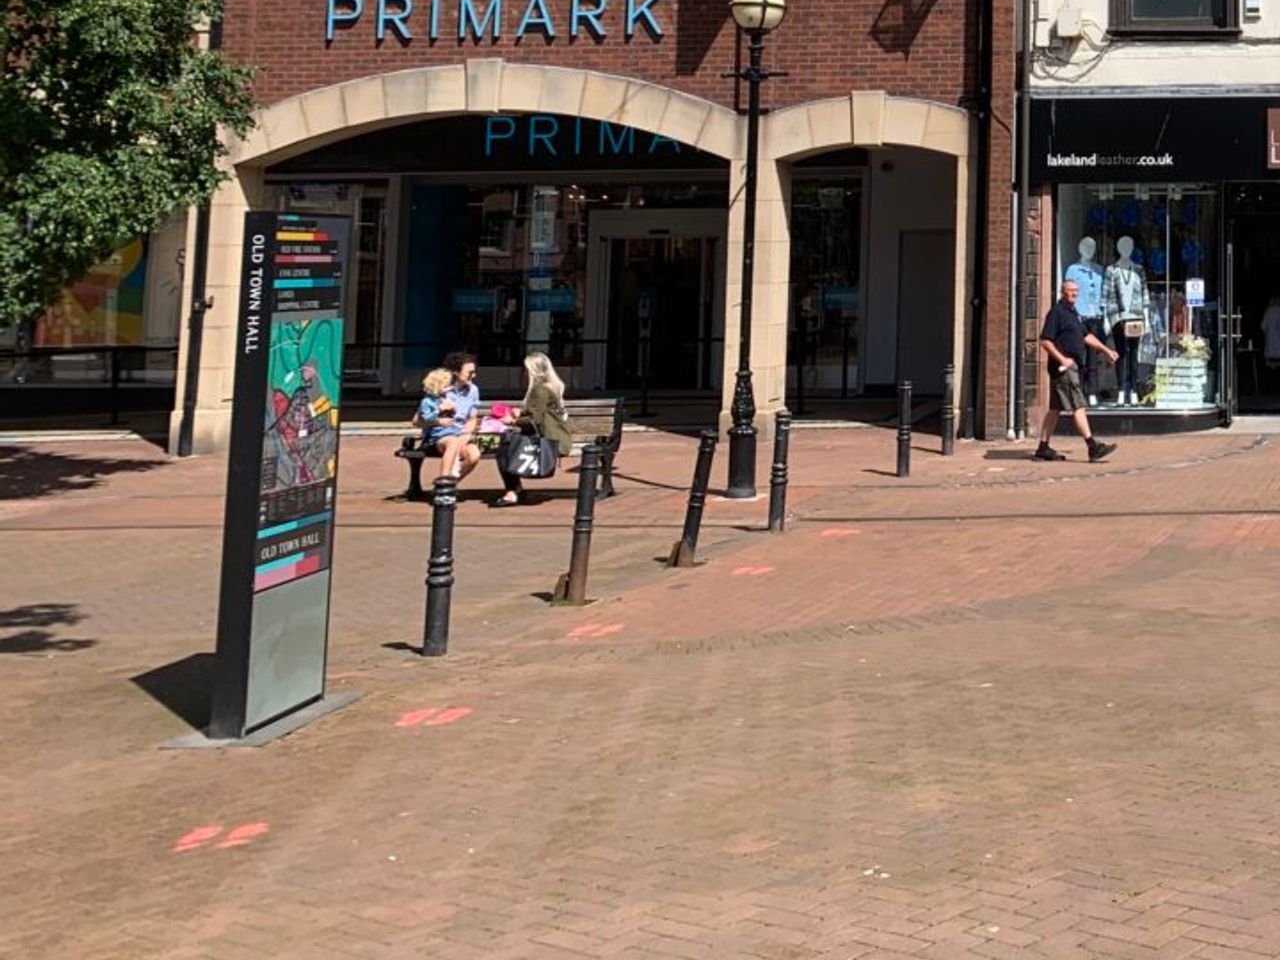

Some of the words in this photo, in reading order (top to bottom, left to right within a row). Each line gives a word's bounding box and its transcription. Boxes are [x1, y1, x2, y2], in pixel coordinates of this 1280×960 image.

[1046, 152, 1174, 167] lakelandleather.co.uk
[251, 234, 265, 263] OLD
[247, 267, 264, 312] TOWN
[244, 315, 261, 354] HALL
[260, 546, 277, 560] OLD
[278, 538, 300, 554] TOWN
[301, 531, 320, 548] HALL
